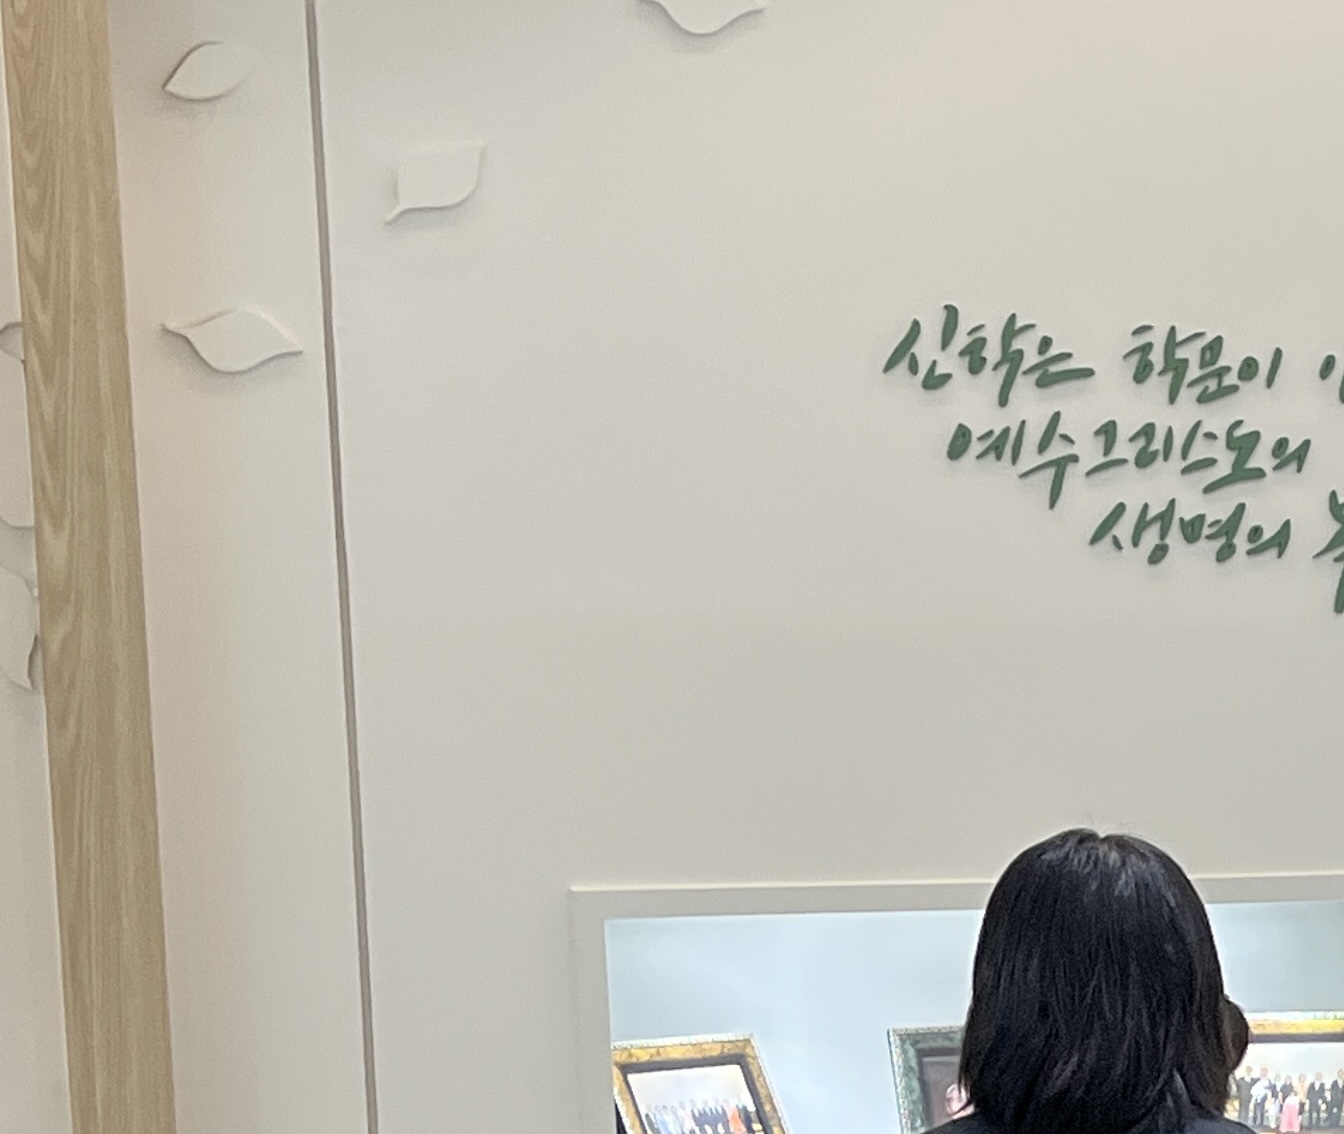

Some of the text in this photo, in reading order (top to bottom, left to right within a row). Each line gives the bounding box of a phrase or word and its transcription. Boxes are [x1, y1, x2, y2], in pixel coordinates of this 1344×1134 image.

[882, 304, 1094, 408] 신학은
[1123, 325, 1283, 405] 학문이
[1090, 497, 1292, 565] 생명의
